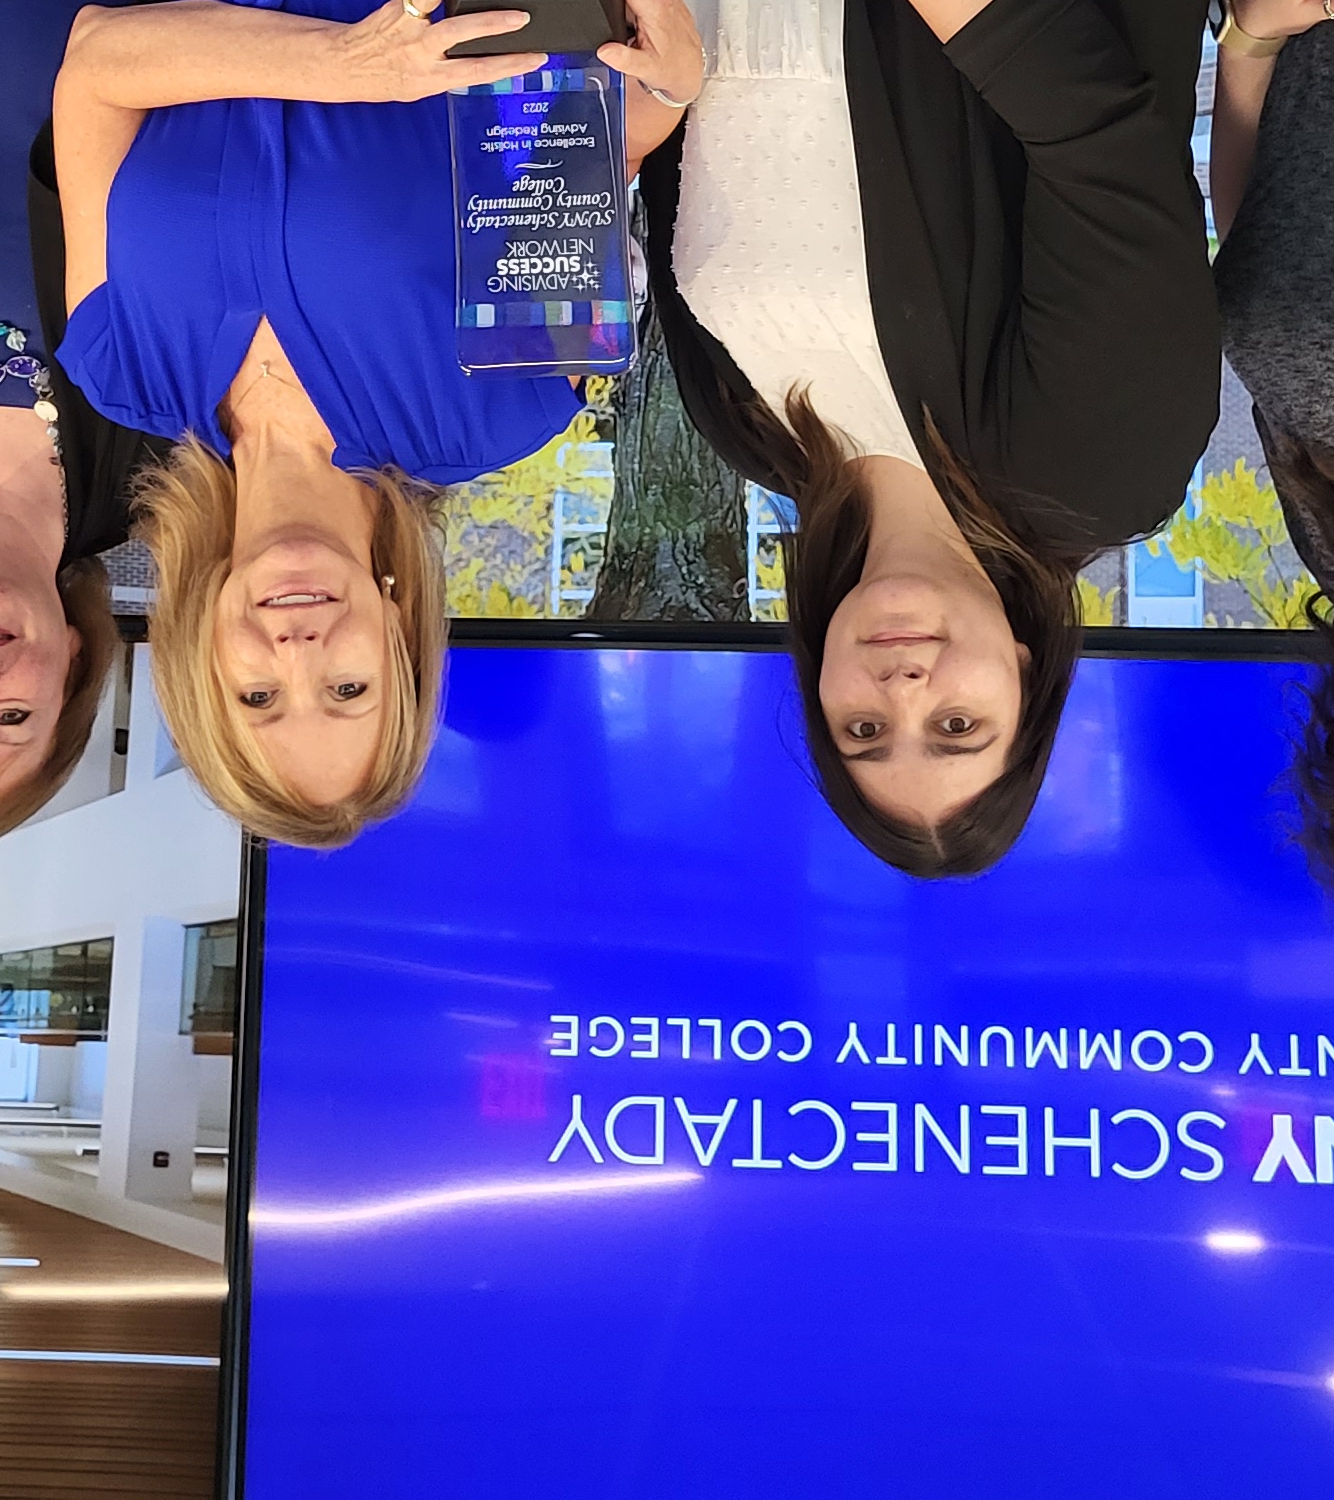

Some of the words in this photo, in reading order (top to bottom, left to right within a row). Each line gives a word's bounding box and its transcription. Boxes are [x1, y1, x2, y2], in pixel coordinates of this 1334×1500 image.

[522, 102, 550, 114] 2023
[486, 125, 539, 138] Redesign
[540, 123, 588, 135] Advising
[480, 141, 519, 153] Holistic
[521, 140, 532, 150] in
[534, 136, 595, 149] Excellence
[511, 174, 565, 196] College
[467, 194, 553, 215] Community
[556, 190, 611, 208] County
[467, 211, 559, 234] Schenectady
[557, 209, 615, 230] SUNY
[504, 237, 595, 258] NETWORK
[495, 255, 581, 275] SUCCESS
[486, 273, 570, 293] ADVISING
[548, 1014, 812, 1063] COLLEGE
[835, 1021, 1214, 1074] COMMUNITY
[547, 1094, 1227, 1182] SCHENECTADY
